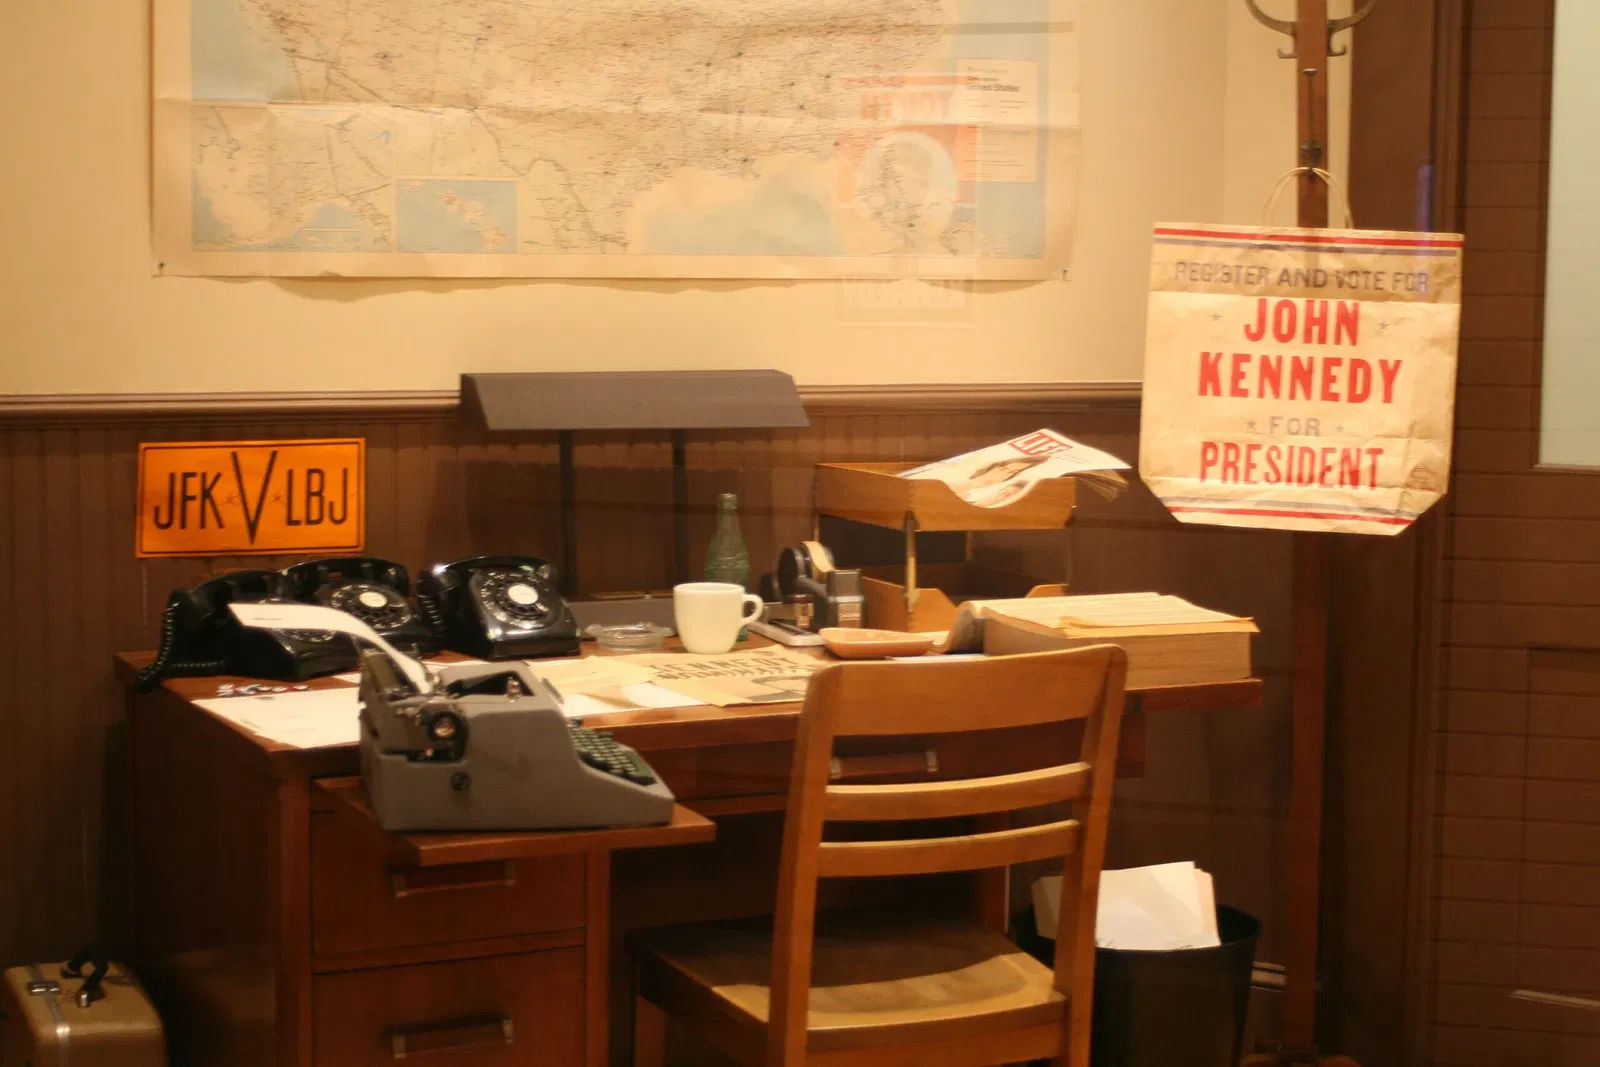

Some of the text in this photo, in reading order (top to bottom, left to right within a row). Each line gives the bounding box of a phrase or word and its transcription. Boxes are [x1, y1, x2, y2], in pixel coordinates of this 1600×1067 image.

[1174, 261, 1429, 293] REGISTER AND VOTE FOR
[1243, 297, 1360, 347] JOHN
[1198, 351, 1402, 404] KENNEDY
[1268, 415, 1322, 437] FOR
[1199, 440, 1384, 490] PRESIDENT
[152, 449, 350, 546] JFK V LBJ
